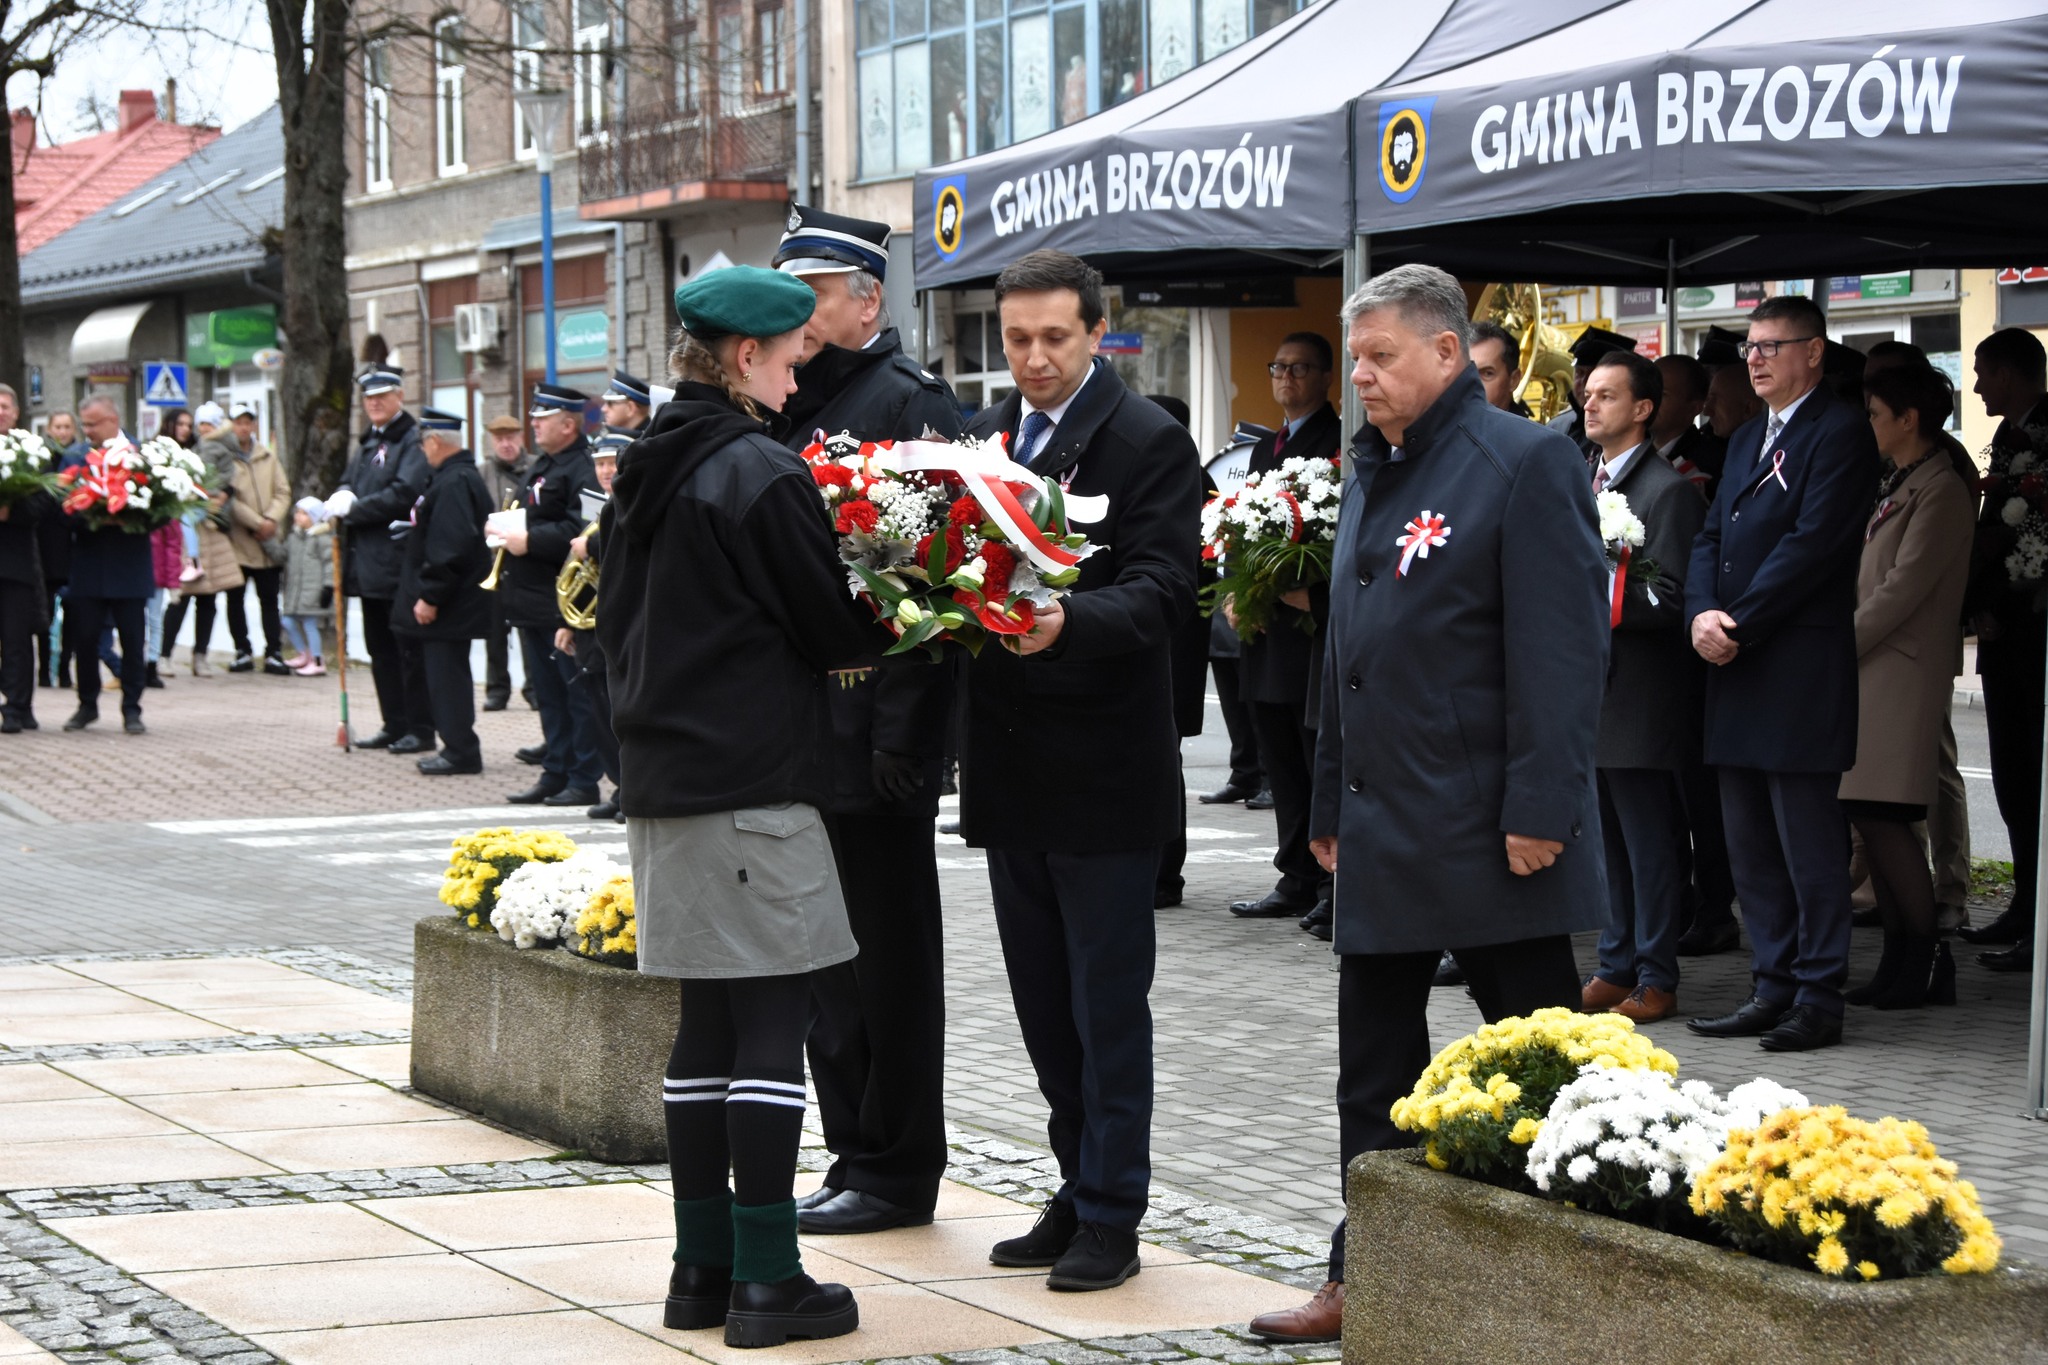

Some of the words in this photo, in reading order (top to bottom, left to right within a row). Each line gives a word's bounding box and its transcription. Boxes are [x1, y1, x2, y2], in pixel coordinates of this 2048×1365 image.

[1470, 80, 1642, 174] GMINA
[1656, 44, 1966, 147] BRZOZÓW
[989, 159, 1099, 238] GMINA
[1106, 132, 1293, 214] BRZOZÓW
[1623, 291, 1651, 304] PARTER
